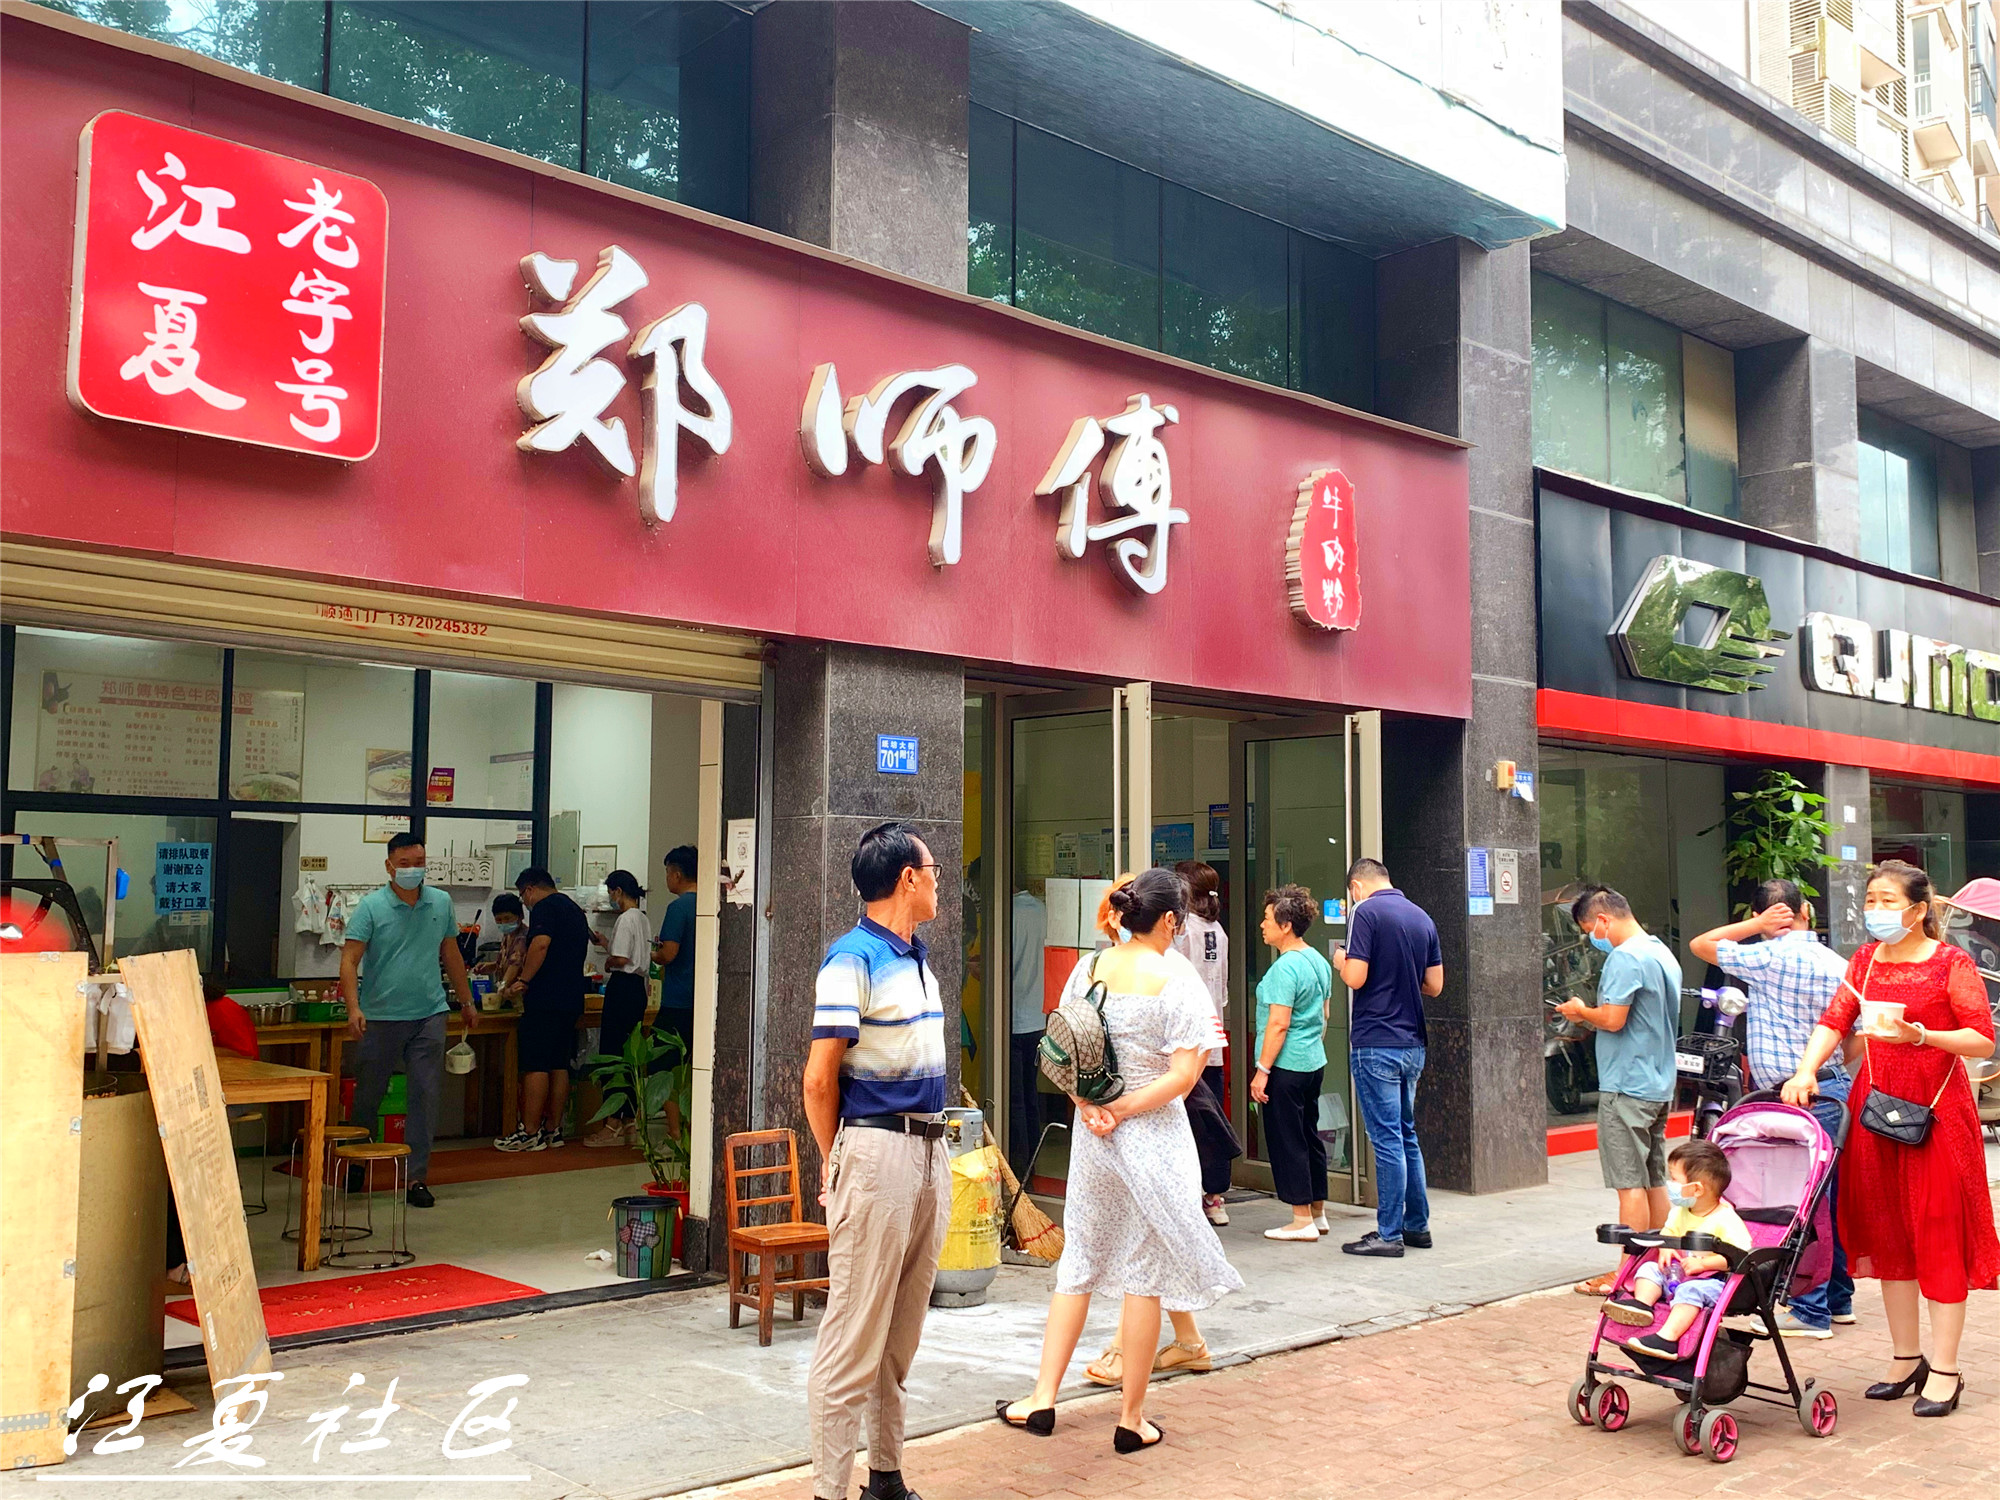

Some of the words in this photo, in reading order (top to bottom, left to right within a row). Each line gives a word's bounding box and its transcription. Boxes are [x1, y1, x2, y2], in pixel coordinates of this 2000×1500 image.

[274, 177, 360, 443] 老字号
[516, 245, 1190, 596] 郑师傅
[389, 612, 488, 637] 13720245332
[158, 848, 210, 860] 请排队取餐
[163, 863, 205, 876] 谢谢配合
[165, 881, 202, 893] 请大家
[159, 896, 208, 909] 戴好口罩
